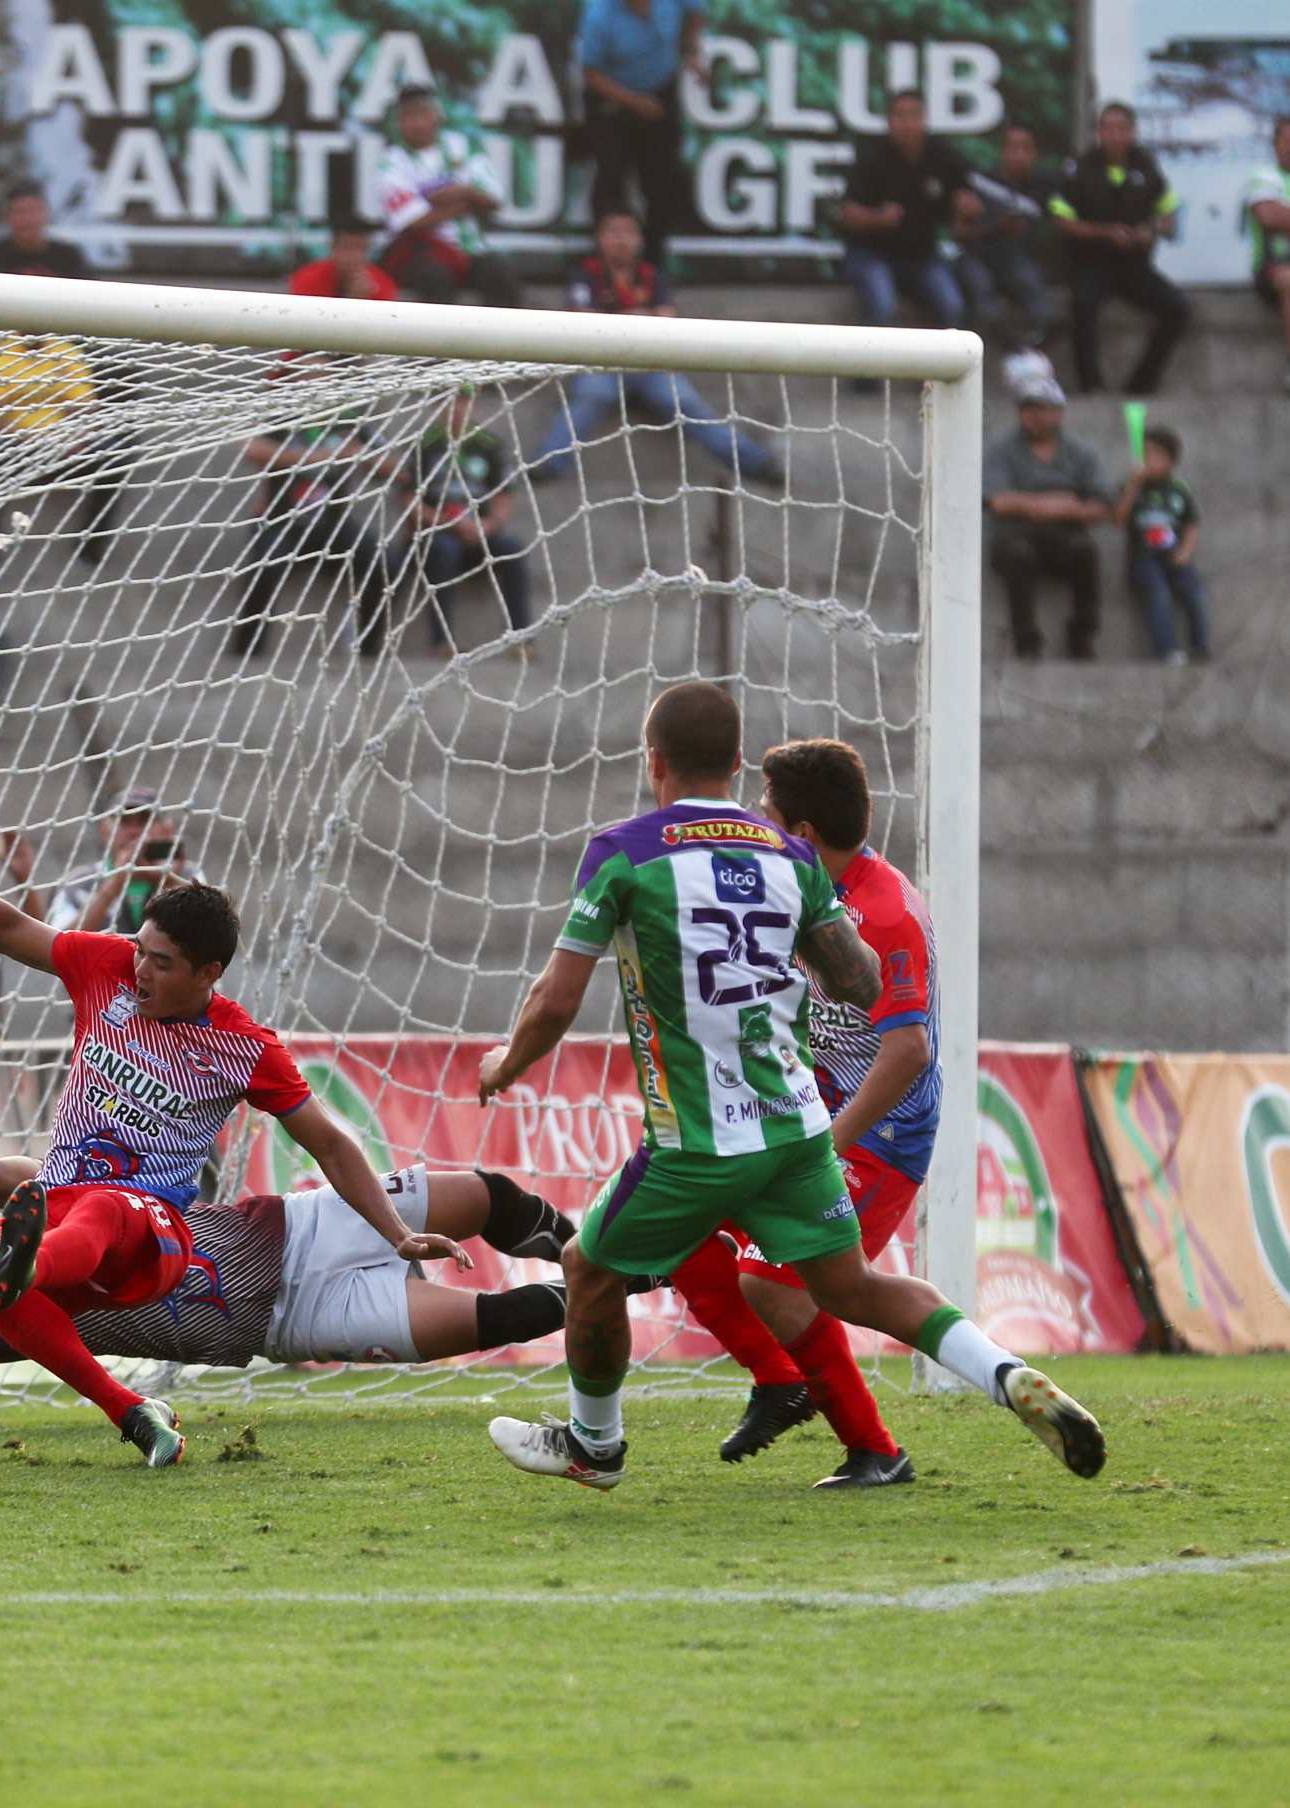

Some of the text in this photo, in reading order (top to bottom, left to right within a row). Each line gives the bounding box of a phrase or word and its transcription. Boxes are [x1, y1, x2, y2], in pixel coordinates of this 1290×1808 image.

[29, 24, 442, 124] APOYA
[679, 34, 1005, 136] CLUB
[93, 127, 857, 232] ANTIU GF
[691, 907, 796, 1006] 25
[85, 1085, 163, 1138] STARBUS
